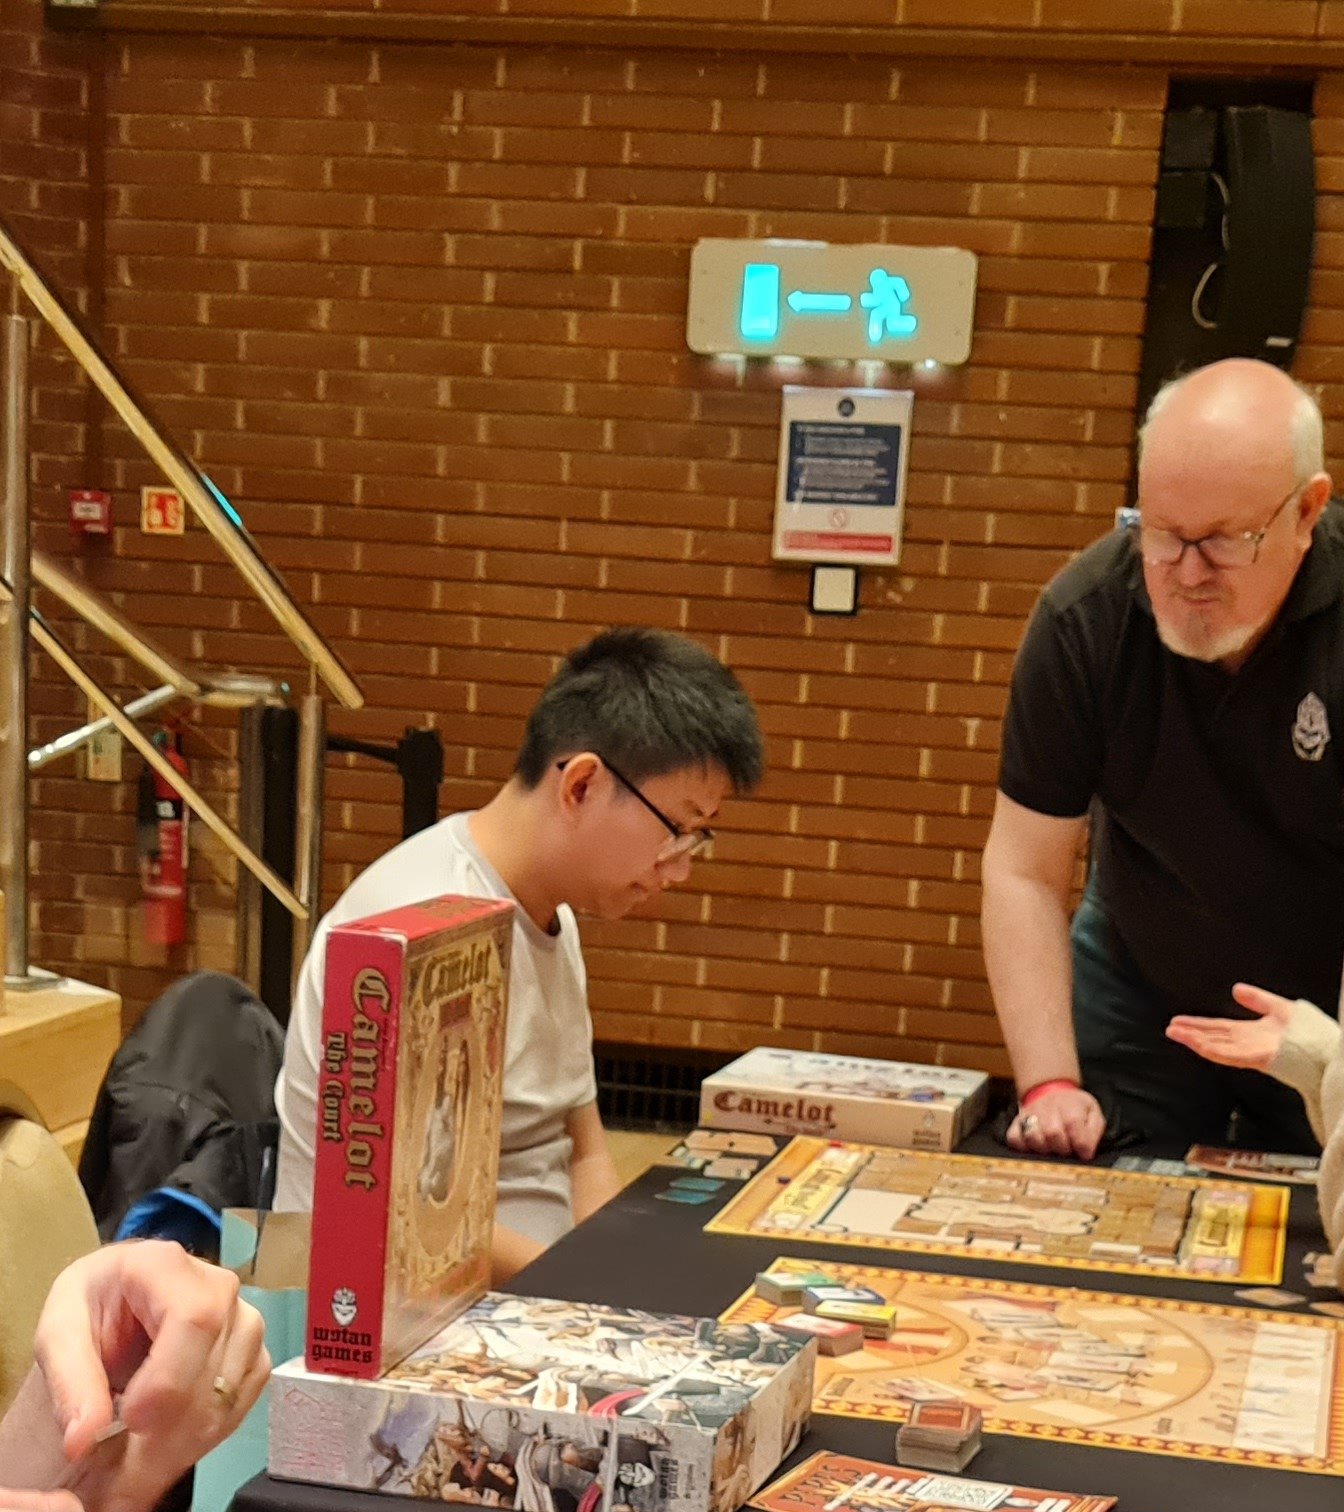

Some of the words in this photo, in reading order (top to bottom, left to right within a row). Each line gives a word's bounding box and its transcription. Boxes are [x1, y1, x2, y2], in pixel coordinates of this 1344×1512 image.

[325, 1032, 348, 1075] The
[344, 966, 392, 1192] Camelot
[322, 1078, 345, 1143] Court
[713, 1089, 836, 1123] Camelot
